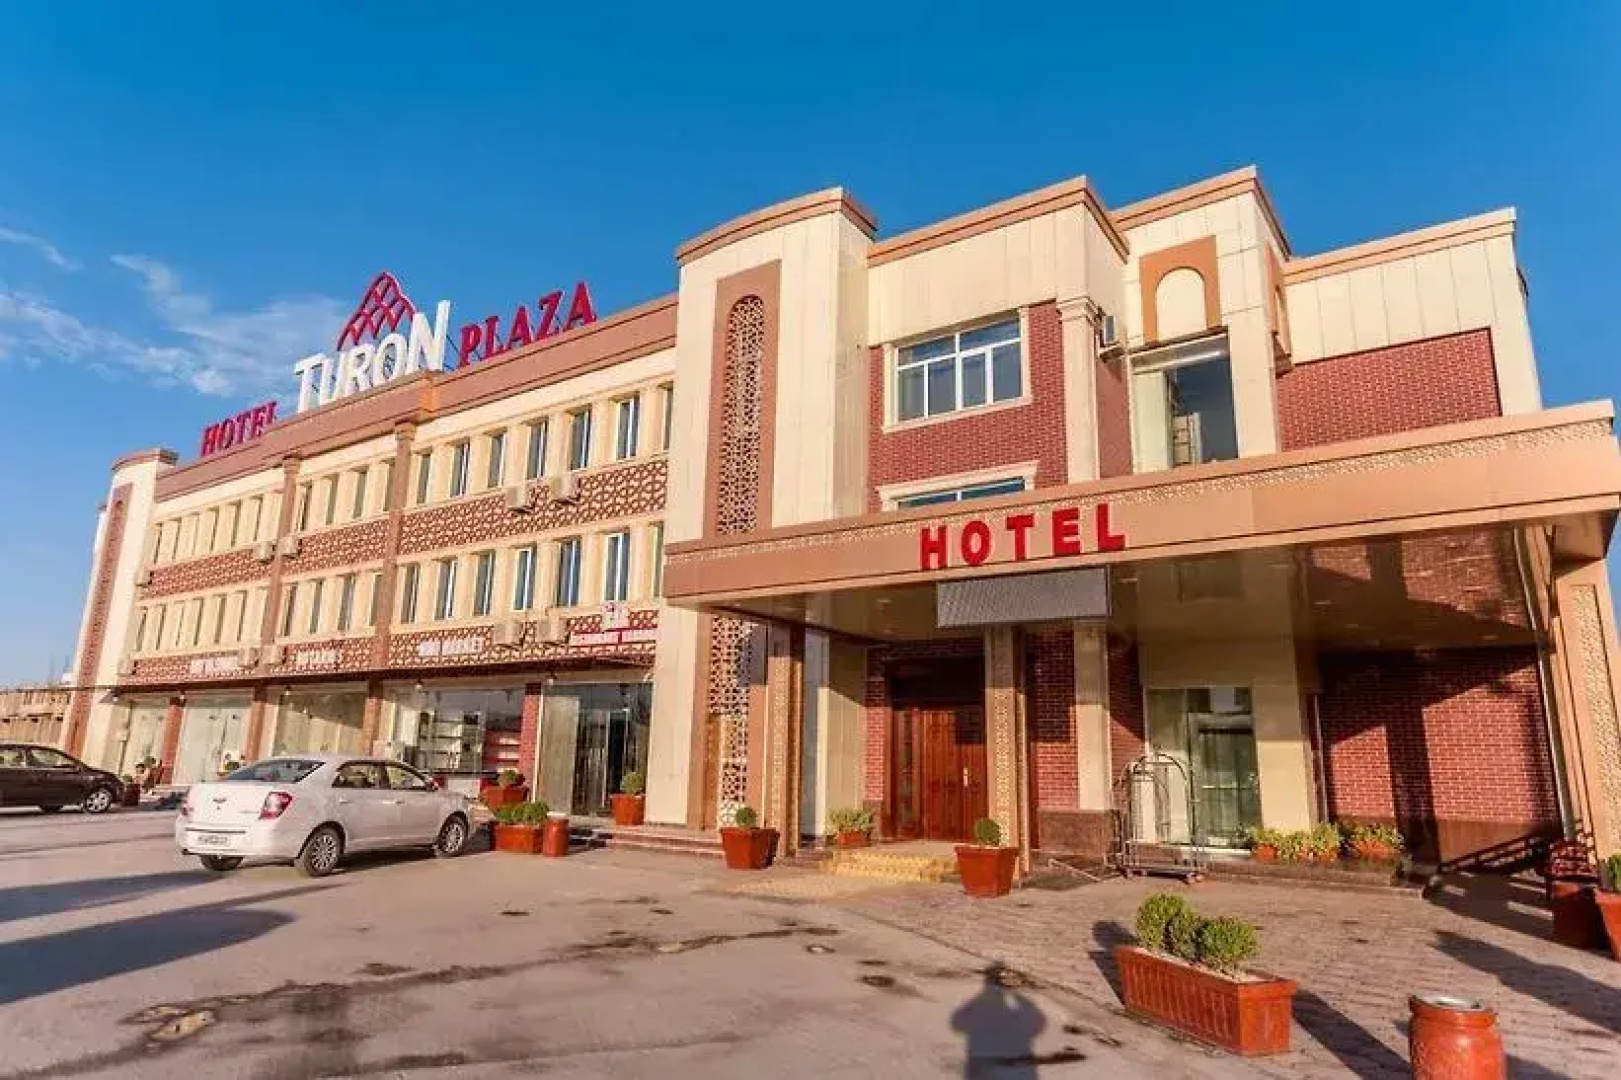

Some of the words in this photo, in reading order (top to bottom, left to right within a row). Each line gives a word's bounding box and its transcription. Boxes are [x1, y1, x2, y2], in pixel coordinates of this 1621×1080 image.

[200, 401, 278, 457] HOTEL
[294, 299, 452, 413] TURON
[458, 281, 598, 368] PLAZA
[920, 503, 1126, 570] HOTEL
